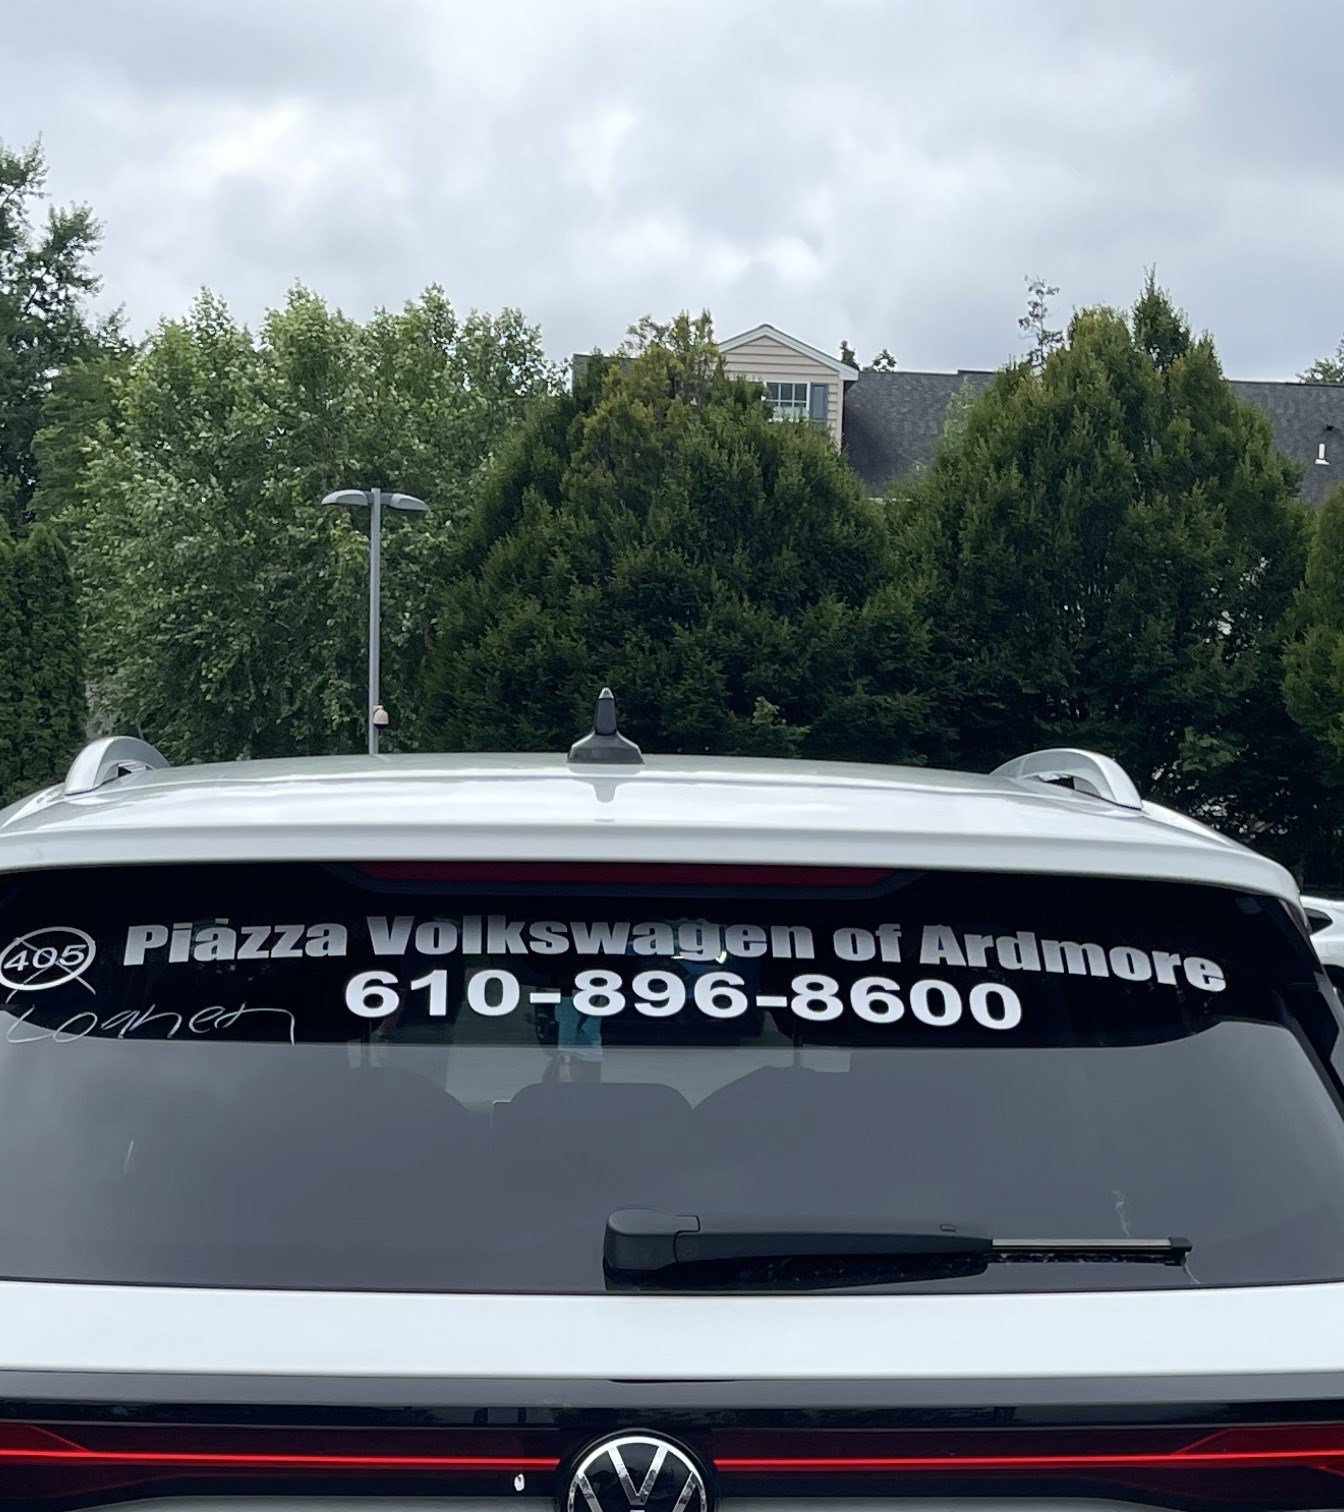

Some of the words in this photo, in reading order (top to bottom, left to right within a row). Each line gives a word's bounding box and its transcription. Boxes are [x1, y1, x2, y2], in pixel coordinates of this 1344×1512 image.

[3, 944, 89, 972] 405
[123, 920, 348, 966] Piazza
[366, 914, 816, 964] Volkswagen
[832, 924, 902, 963] of
[918, 925, 1227, 993] Ardmore
[344, 970, 1022, 1030] 610-896-8600
